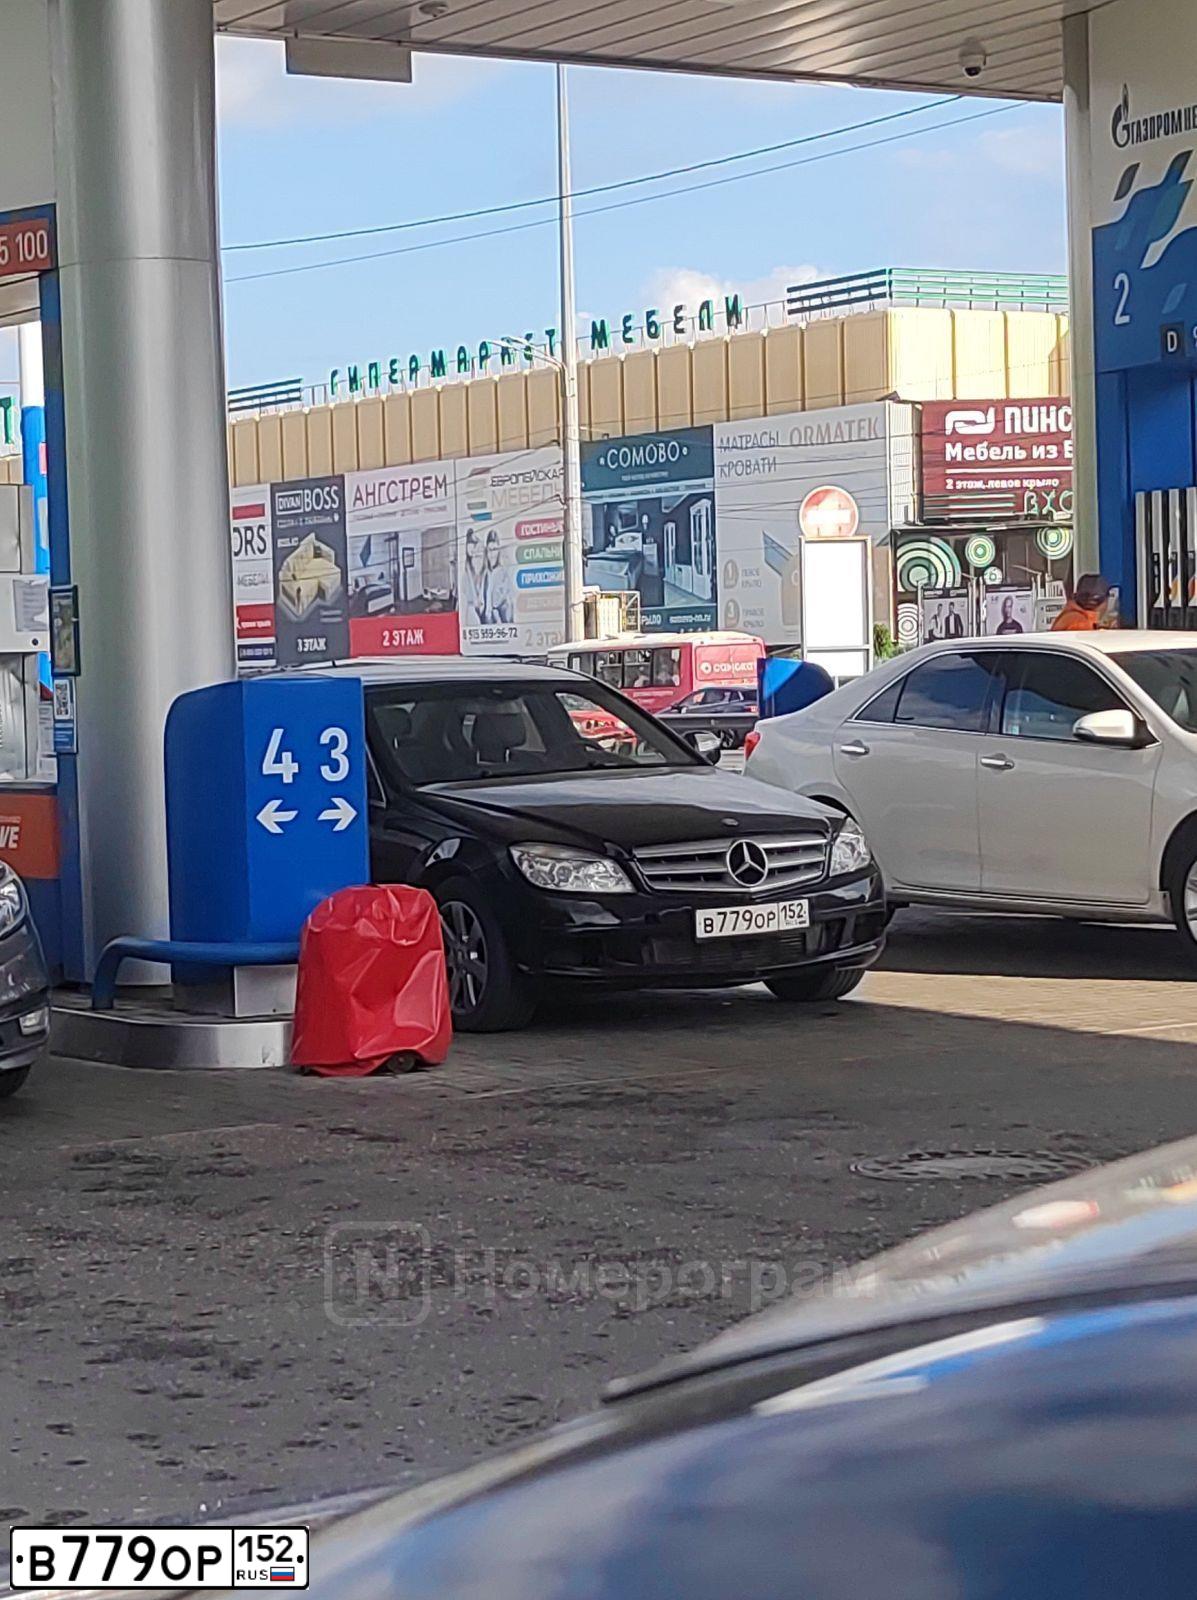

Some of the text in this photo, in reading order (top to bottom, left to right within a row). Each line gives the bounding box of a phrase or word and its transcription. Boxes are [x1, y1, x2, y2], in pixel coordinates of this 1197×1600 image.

[15, 230, 48, 262] 100
[1114, 272, 1130, 325] 2
[330, 294, 743, 396] ГИПЕРМАРКЕТ МЕБЕЛИ
[1167, 331, 1178, 352] D
[790, 417, 879, 446] ORMATEK
[1004, 405, 1073, 434] ПИНС
[607, 441, 680, 469] СОМОВО
[719, 431, 779, 452] МАТРАСЫ
[945, 440, 1027, 461] Мебель
[1032, 444, 1059, 459] из
[720, 456, 776, 478] КРОВАТИ
[304, 485, 339, 512] BOSS
[353, 473, 448, 508] АНГСТРЕМ
[383, 629, 424, 646] 2 ЭТАЖ
[262, 727, 350, 784] 4 3
[703, 902, 804, 934] В779ОР 152
